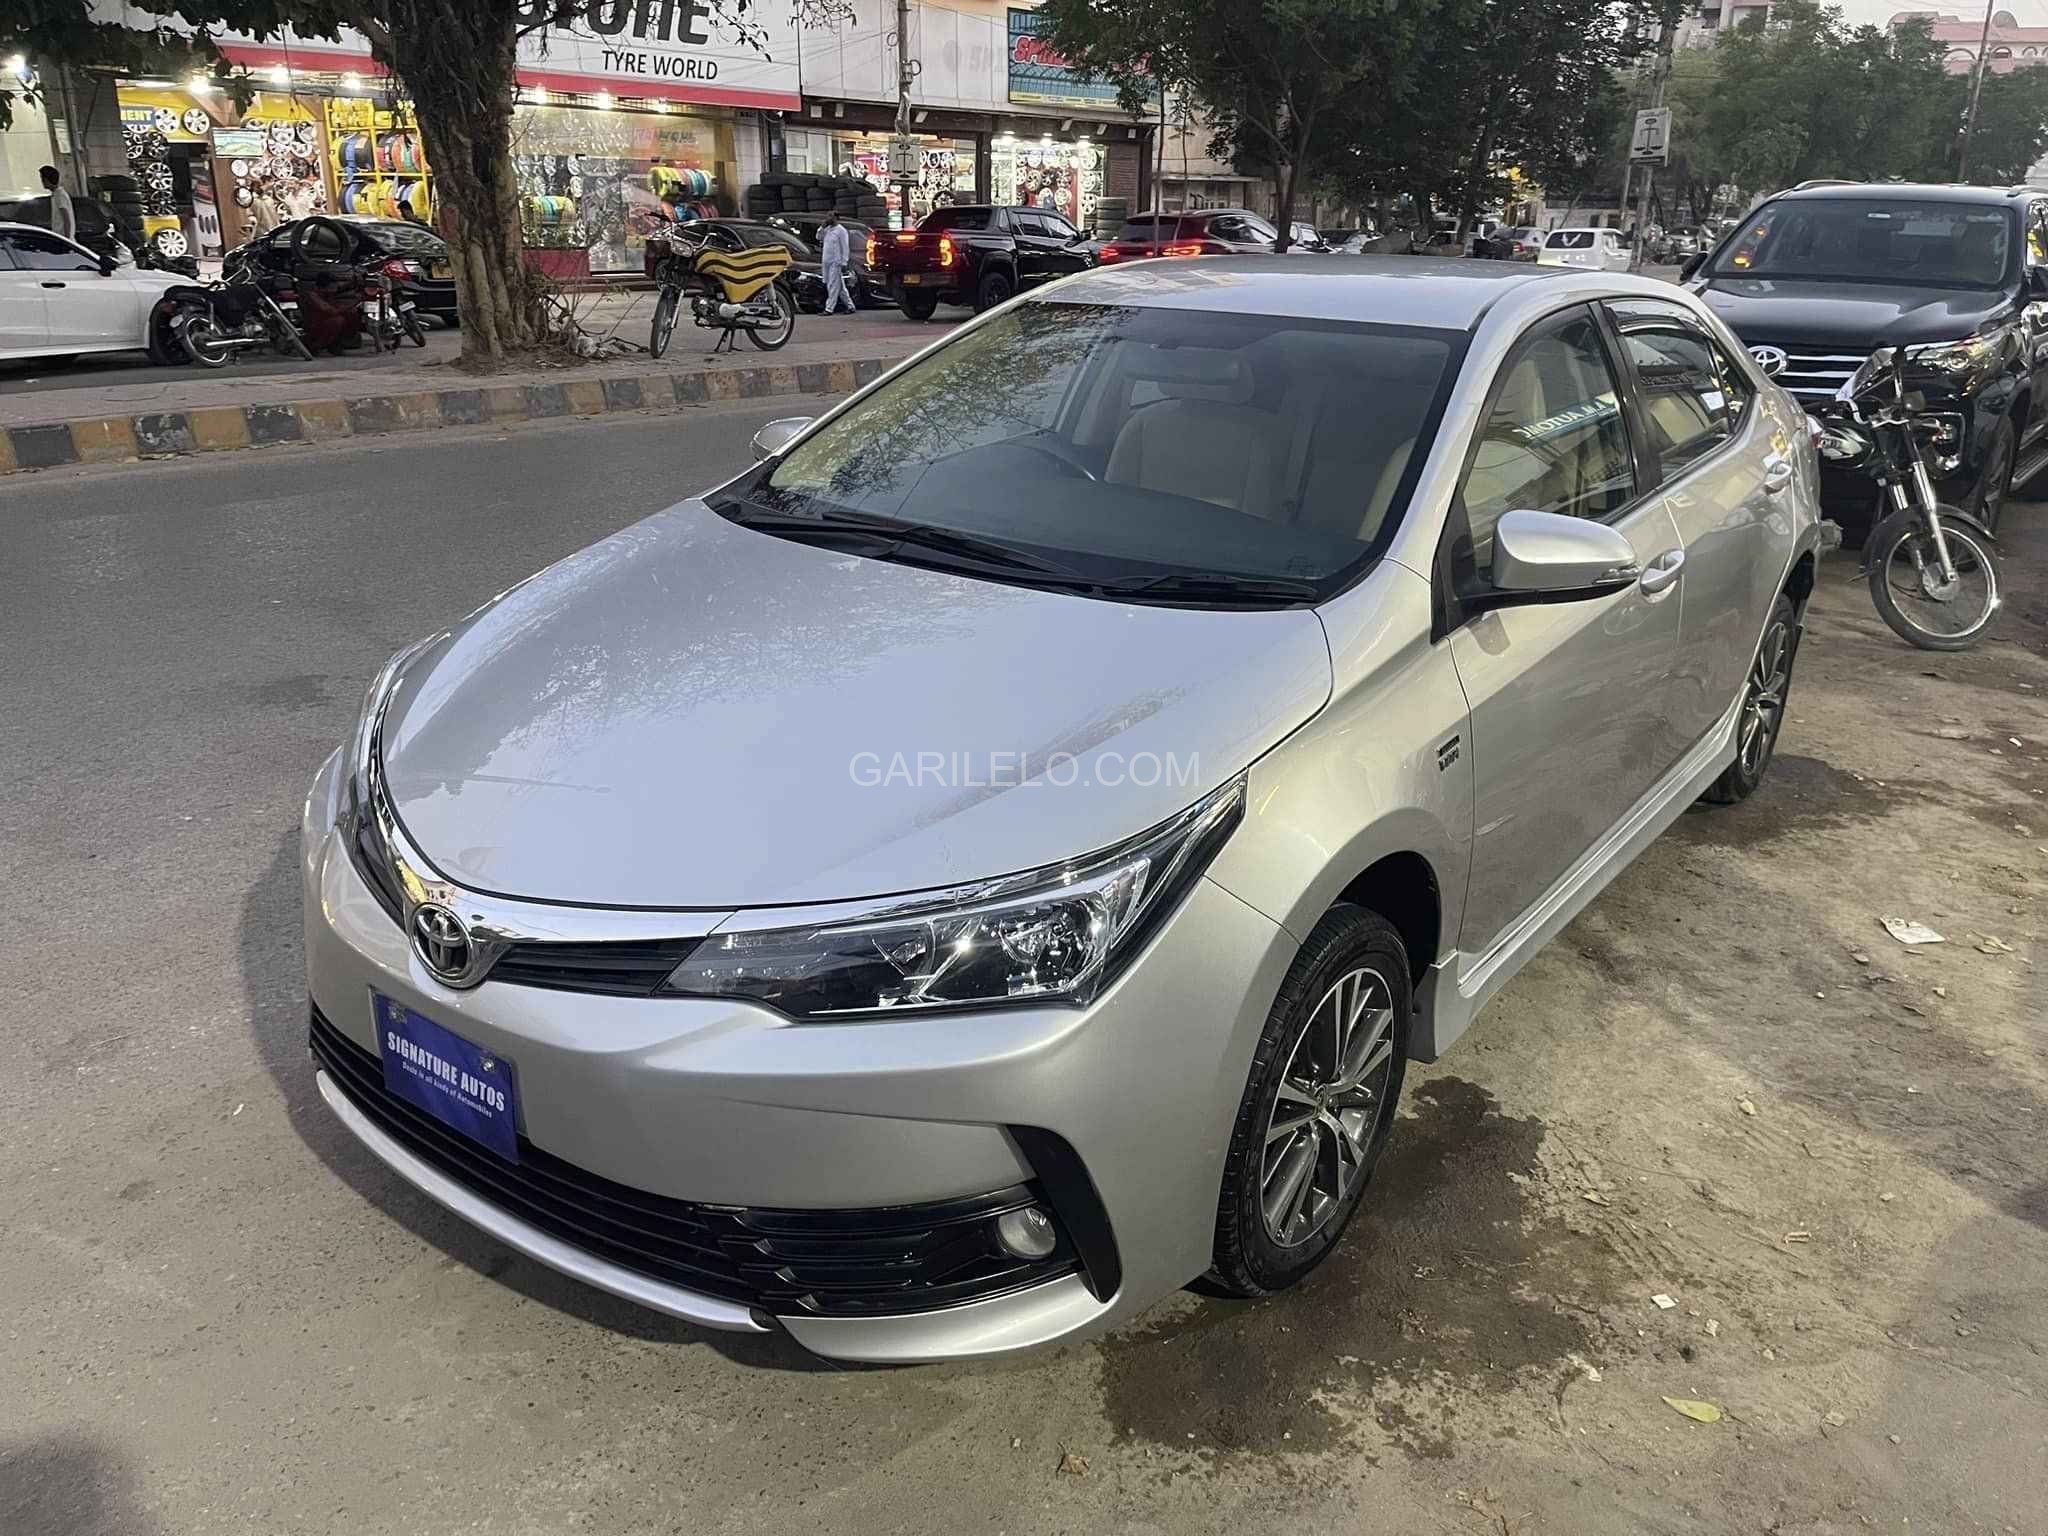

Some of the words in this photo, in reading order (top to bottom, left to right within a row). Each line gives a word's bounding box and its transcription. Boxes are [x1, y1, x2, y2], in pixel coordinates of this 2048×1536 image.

[602, 50, 647, 74] TYRE
[653, 55, 718, 80] WORLD
[388, 1031, 458, 1086] SIGNATURE
[461, 1072, 505, 1112] AUTOS
